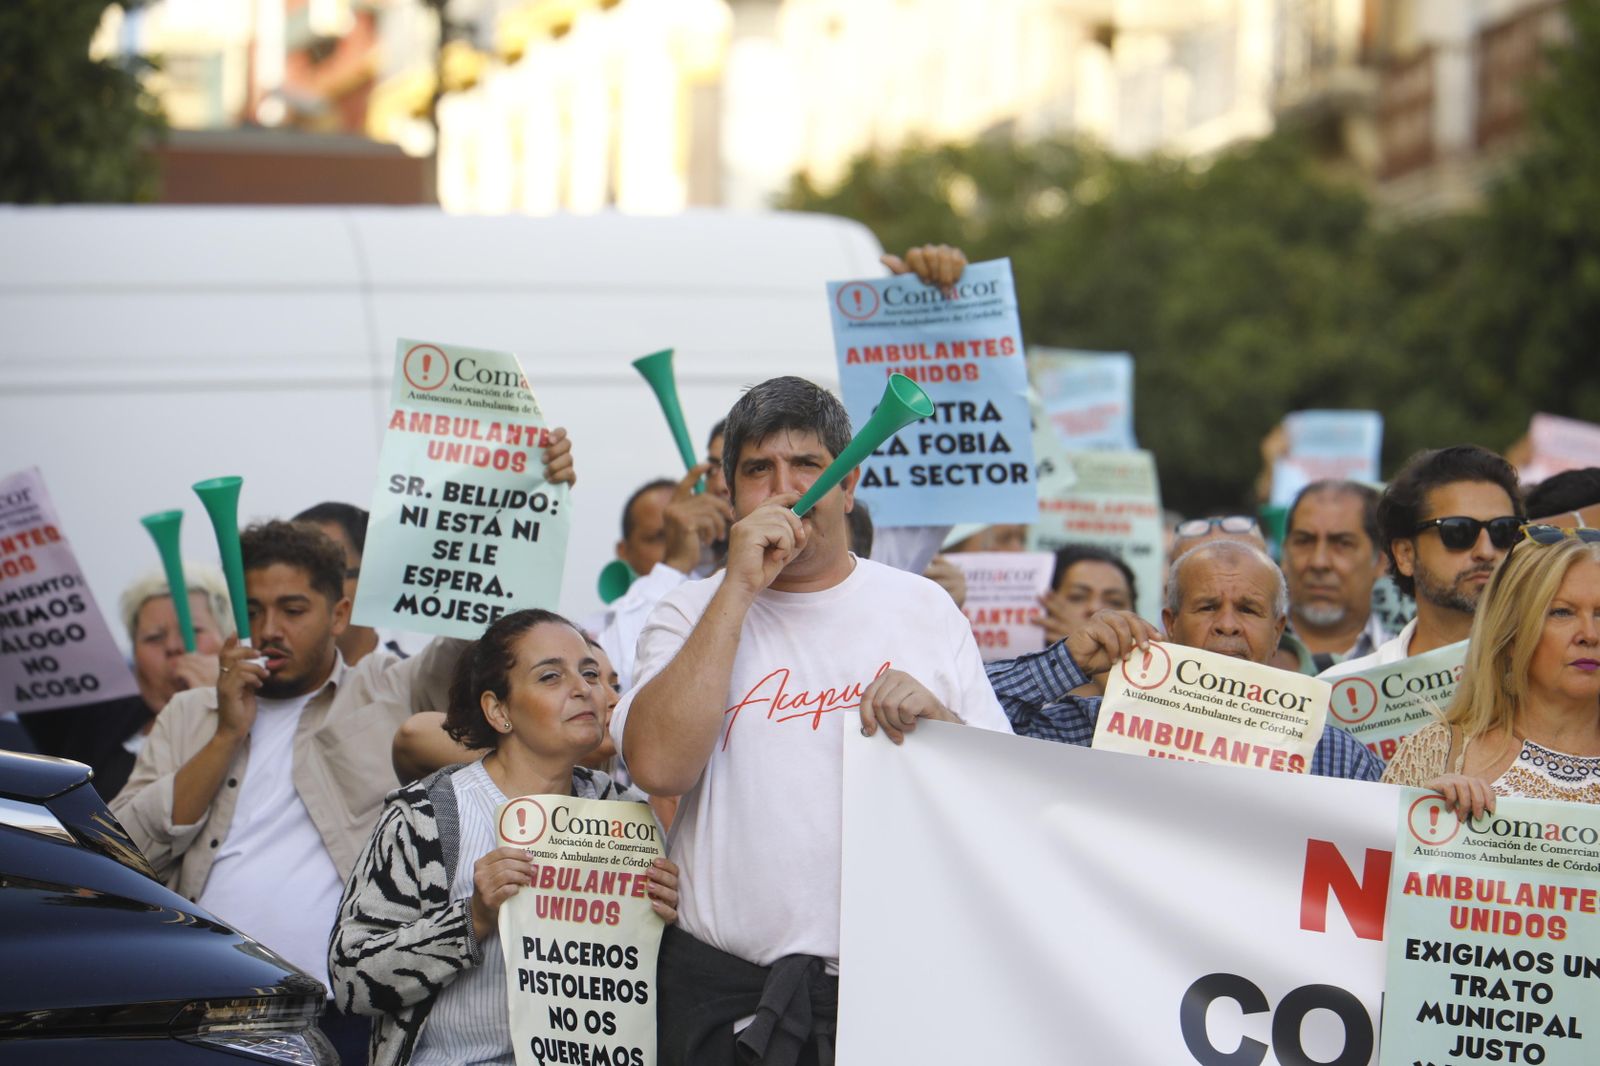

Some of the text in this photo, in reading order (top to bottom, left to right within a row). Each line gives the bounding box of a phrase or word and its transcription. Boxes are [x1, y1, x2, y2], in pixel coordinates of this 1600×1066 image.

[846, 336, 1016, 365] AMBULANTES
[408, 391, 462, 406] Autónomos
[464, 398, 519, 413] Ambulantes
[522, 405, 532, 413] de
[502, 391, 514, 400] de
[426, 440, 528, 474] UNIDOS
[918, 431, 1013, 455] FOBIA
[860, 466, 900, 488] AL
[909, 462, 1030, 487] SECTOR
[389, 473, 560, 516] SR. BELLIDO:
[399, 504, 541, 542] NI ESTÁ NI
[432, 539, 498, 565] SE LE
[402, 565, 514, 599] ESPERA.
[21, 655, 59, 676] NO
[14, 673, 100, 701] ACOSO
[1175, 658, 1313, 713] Comacor
[1440, 689, 1453, 699] de
[1122, 688, 1304, 740] Autónomos Ambulantes de Córdoba
[1169, 685, 1310, 727] Asociación de Comerciantes
[1107, 710, 1306, 774] AMBULANTES
[551, 805, 657, 842] Comacor
[548, 835, 659, 855] Asociación de Comerciantes
[560, 851, 609, 865] Ambulantes
[610, 856, 622, 866] de
[1413, 845, 1477, 861] Autónomos
[1479, 852, 1544, 867] Ambulantes
[1546, 858, 1560, 869] de
[1462, 836, 1521, 851] Asociación
[1523, 841, 1538, 852] de
[535, 894, 621, 927] UNIDOS
[1449, 904, 1568, 942] UNIDOS
[522, 936, 640, 971] PLACEROS
[1405, 938, 1555, 975] EXIGIMOS
[518, 967, 649, 1005] PISTOLEROS
[1450, 972, 1554, 1006] TRATO
[548, 1005, 617, 1037] NO OS
[1416, 1000, 1584, 1040] MUNICIPAL
[530, 1036, 645, 1066] QUEREMOS
[1448, 1034, 1547, 1066] JUSTO
